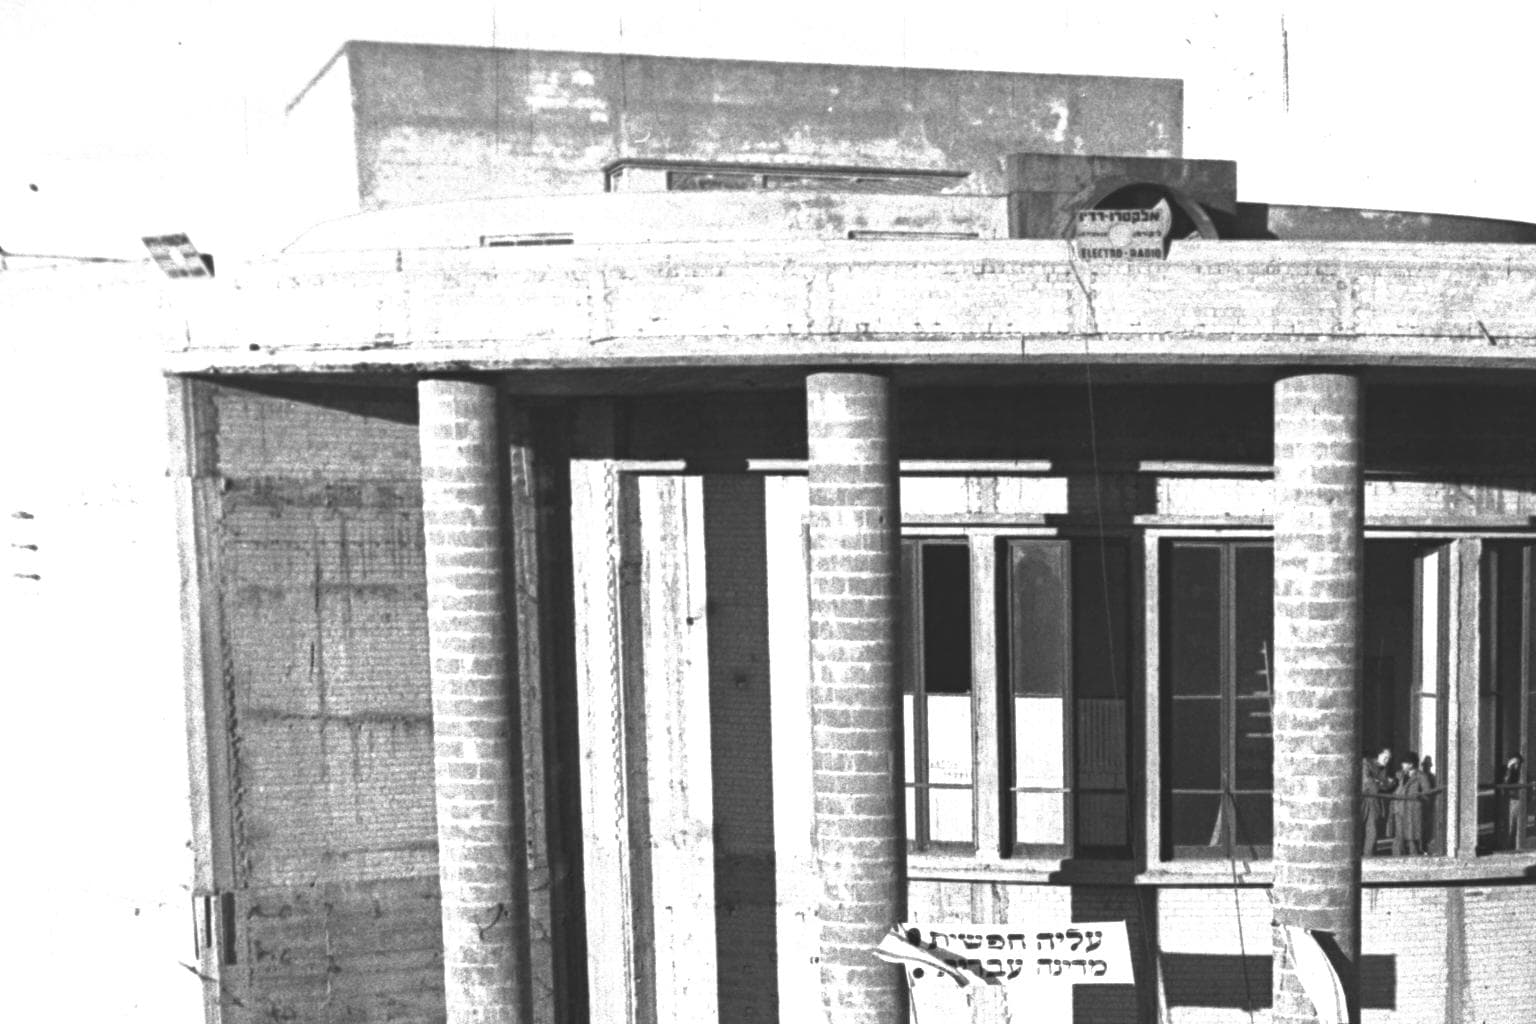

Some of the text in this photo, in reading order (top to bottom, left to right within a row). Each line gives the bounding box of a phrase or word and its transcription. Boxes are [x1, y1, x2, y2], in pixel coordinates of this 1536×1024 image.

[927, 929, 1102, 952] עליה חפשית
[1037, 958, 1108, 977] מדינה
